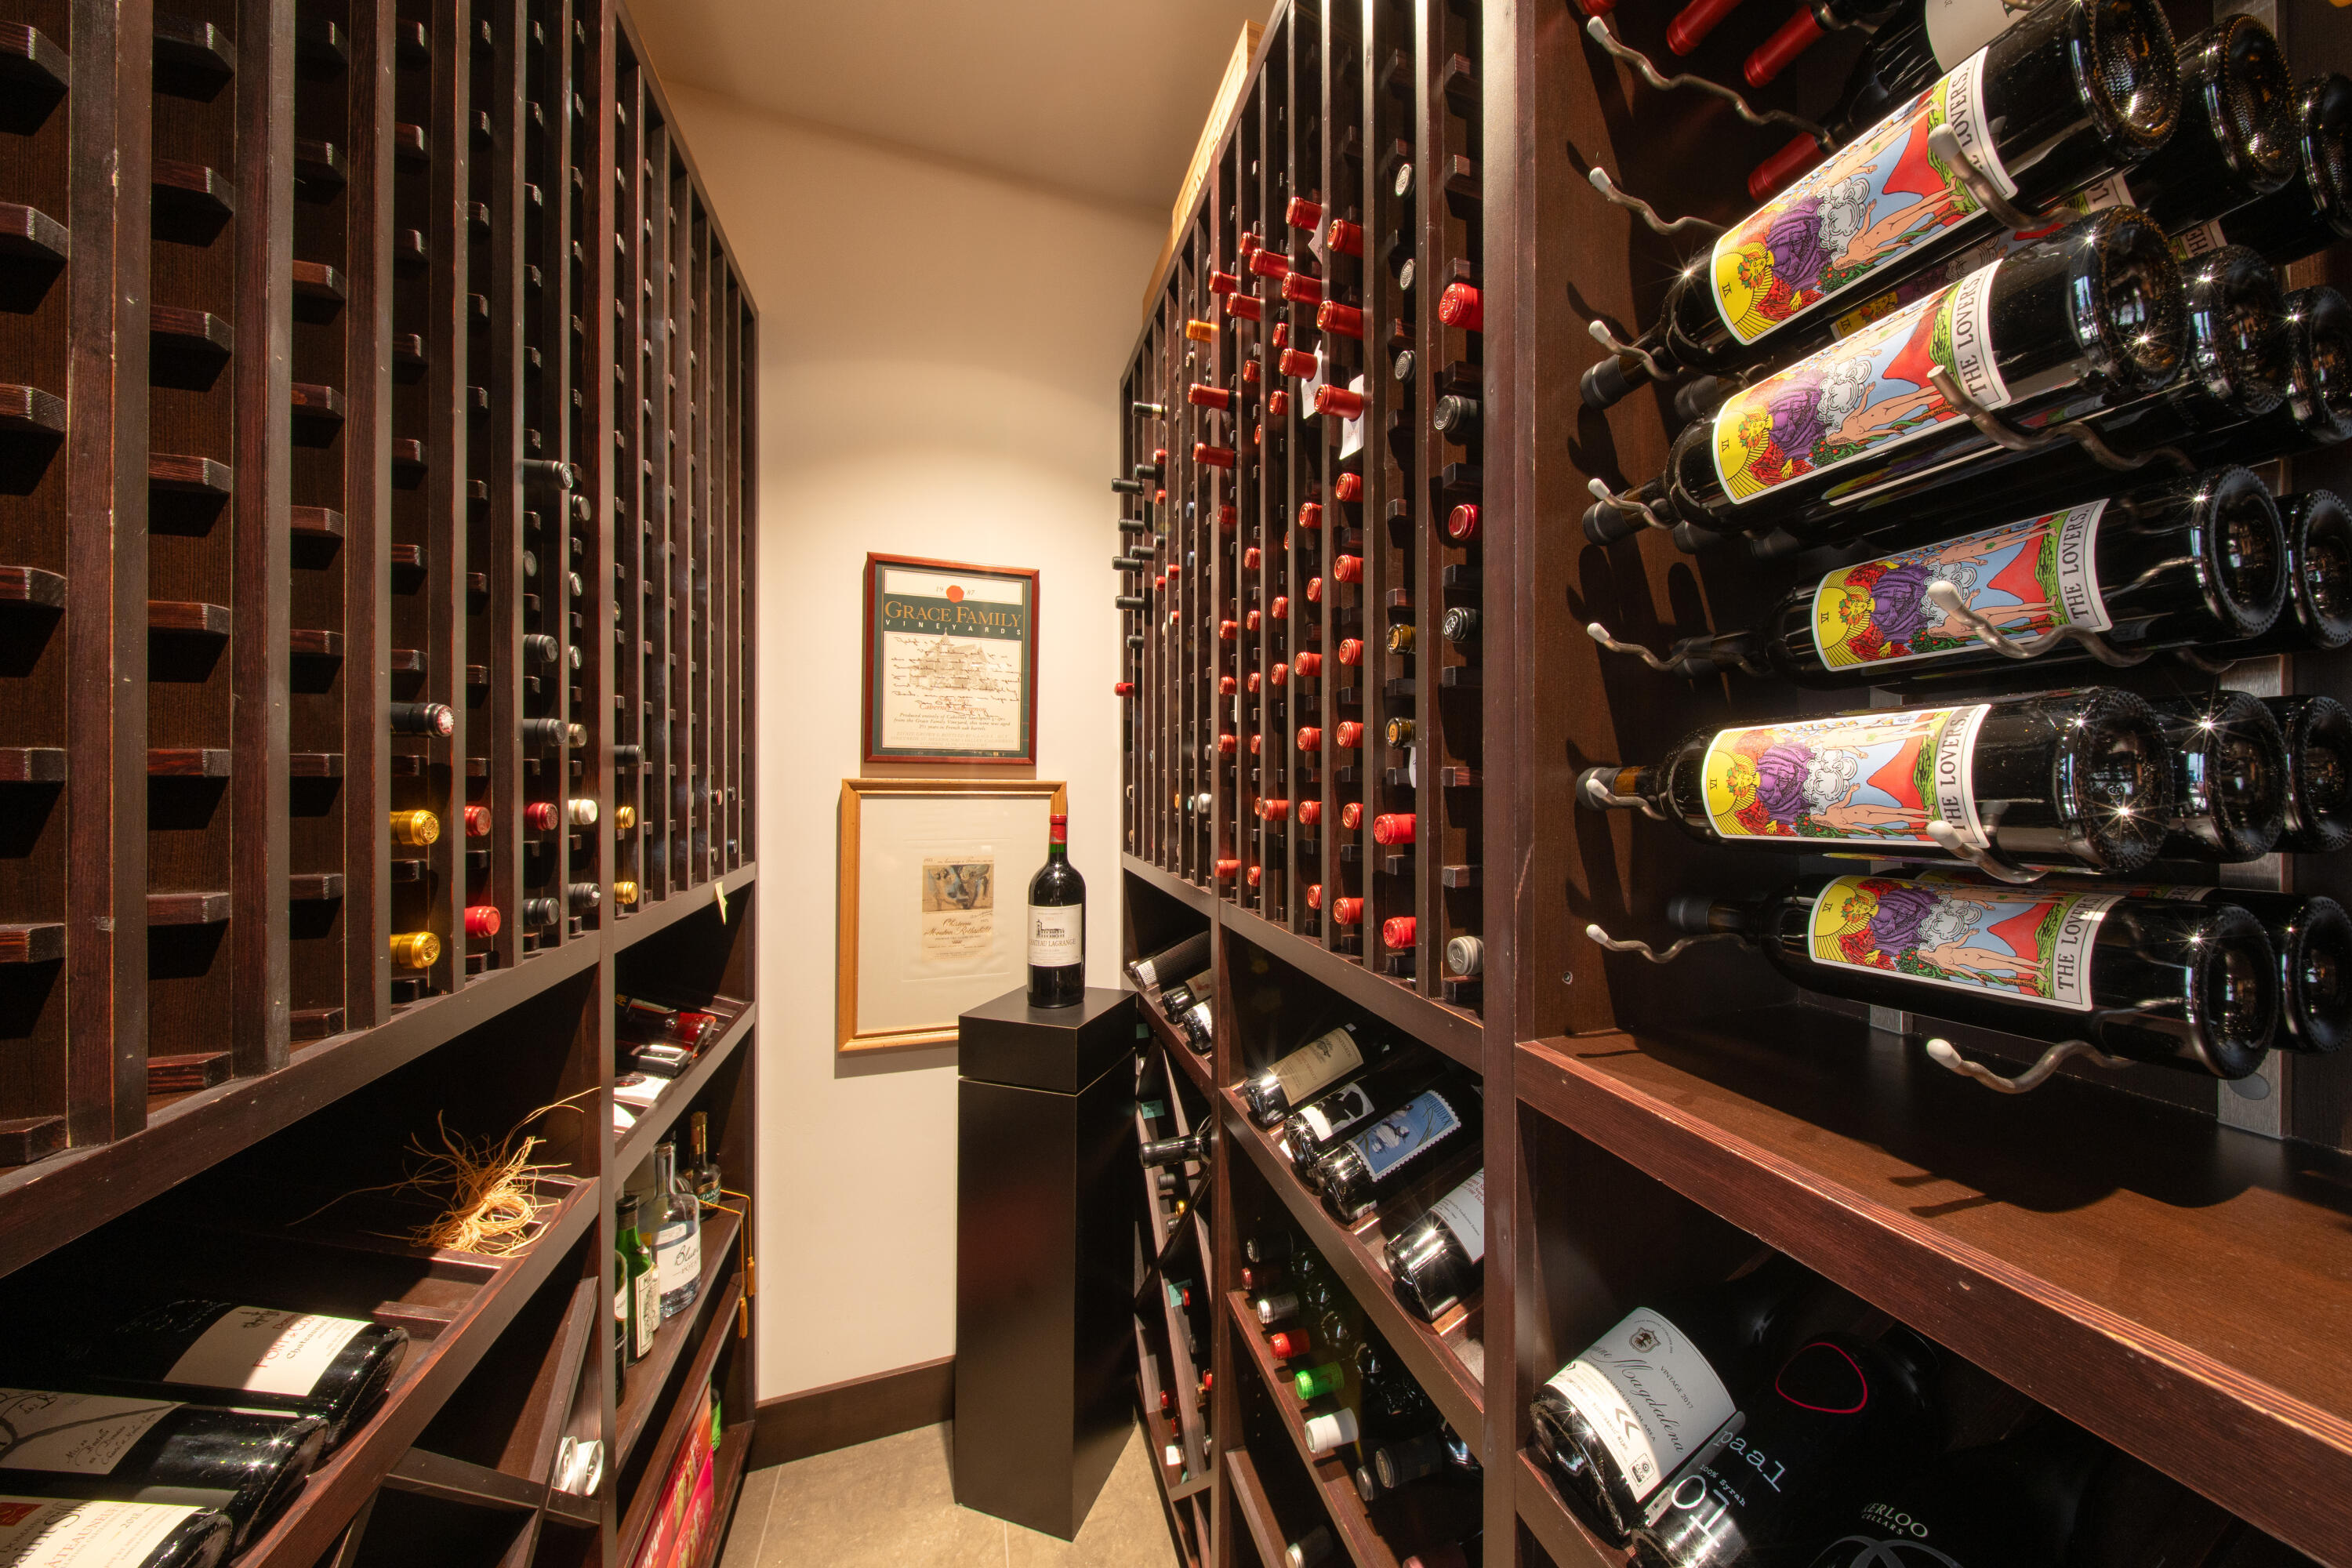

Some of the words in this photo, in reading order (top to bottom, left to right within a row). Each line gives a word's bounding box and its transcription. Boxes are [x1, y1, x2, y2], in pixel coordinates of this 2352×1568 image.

[1950, 67, 1973, 148] LOVERS.
[1722, 281, 1732, 299] VI
[1957, 273, 1983, 350] LOVERS.
[1960, 354, 1987, 397] THE
[1721, 437, 1730, 453] VI
[2063, 509, 2090, 576] LOVERS.
[884, 601, 952, 622] GRACE
[956, 606, 1022, 627] FAMILY
[1820, 611, 1829, 624] VI
[2065, 583, 2089, 619] THE
[885, 619, 1022, 636] VINEYARDS
[1940, 714, 1969, 787] LOVERS.
[1710, 778, 1718, 789] VI
[1822, 902, 1833, 913] VI
[2061, 897, 2101, 946] LOVERS.
[2057, 953, 2074, 991] THE
[1589, 1350, 1684, 1454] Magdalena
[1660, 1365, 1682, 1394] VINTAGE
[1680, 1392, 1694, 1410] 2017
[1643, 1423, 1656, 1443] AREA
[1713, 1431, 1786, 1493] paal
[1699, 1464, 1719, 1479] 100%
[1719, 1479, 1746, 1508] Syrah
[120, 1512, 143, 1529] 2018
[1861, 1502, 1929, 1537] ERLOO
[1861, 1513, 1904, 1535] CELLARS
[6, 1527, 58, 1566] aint
